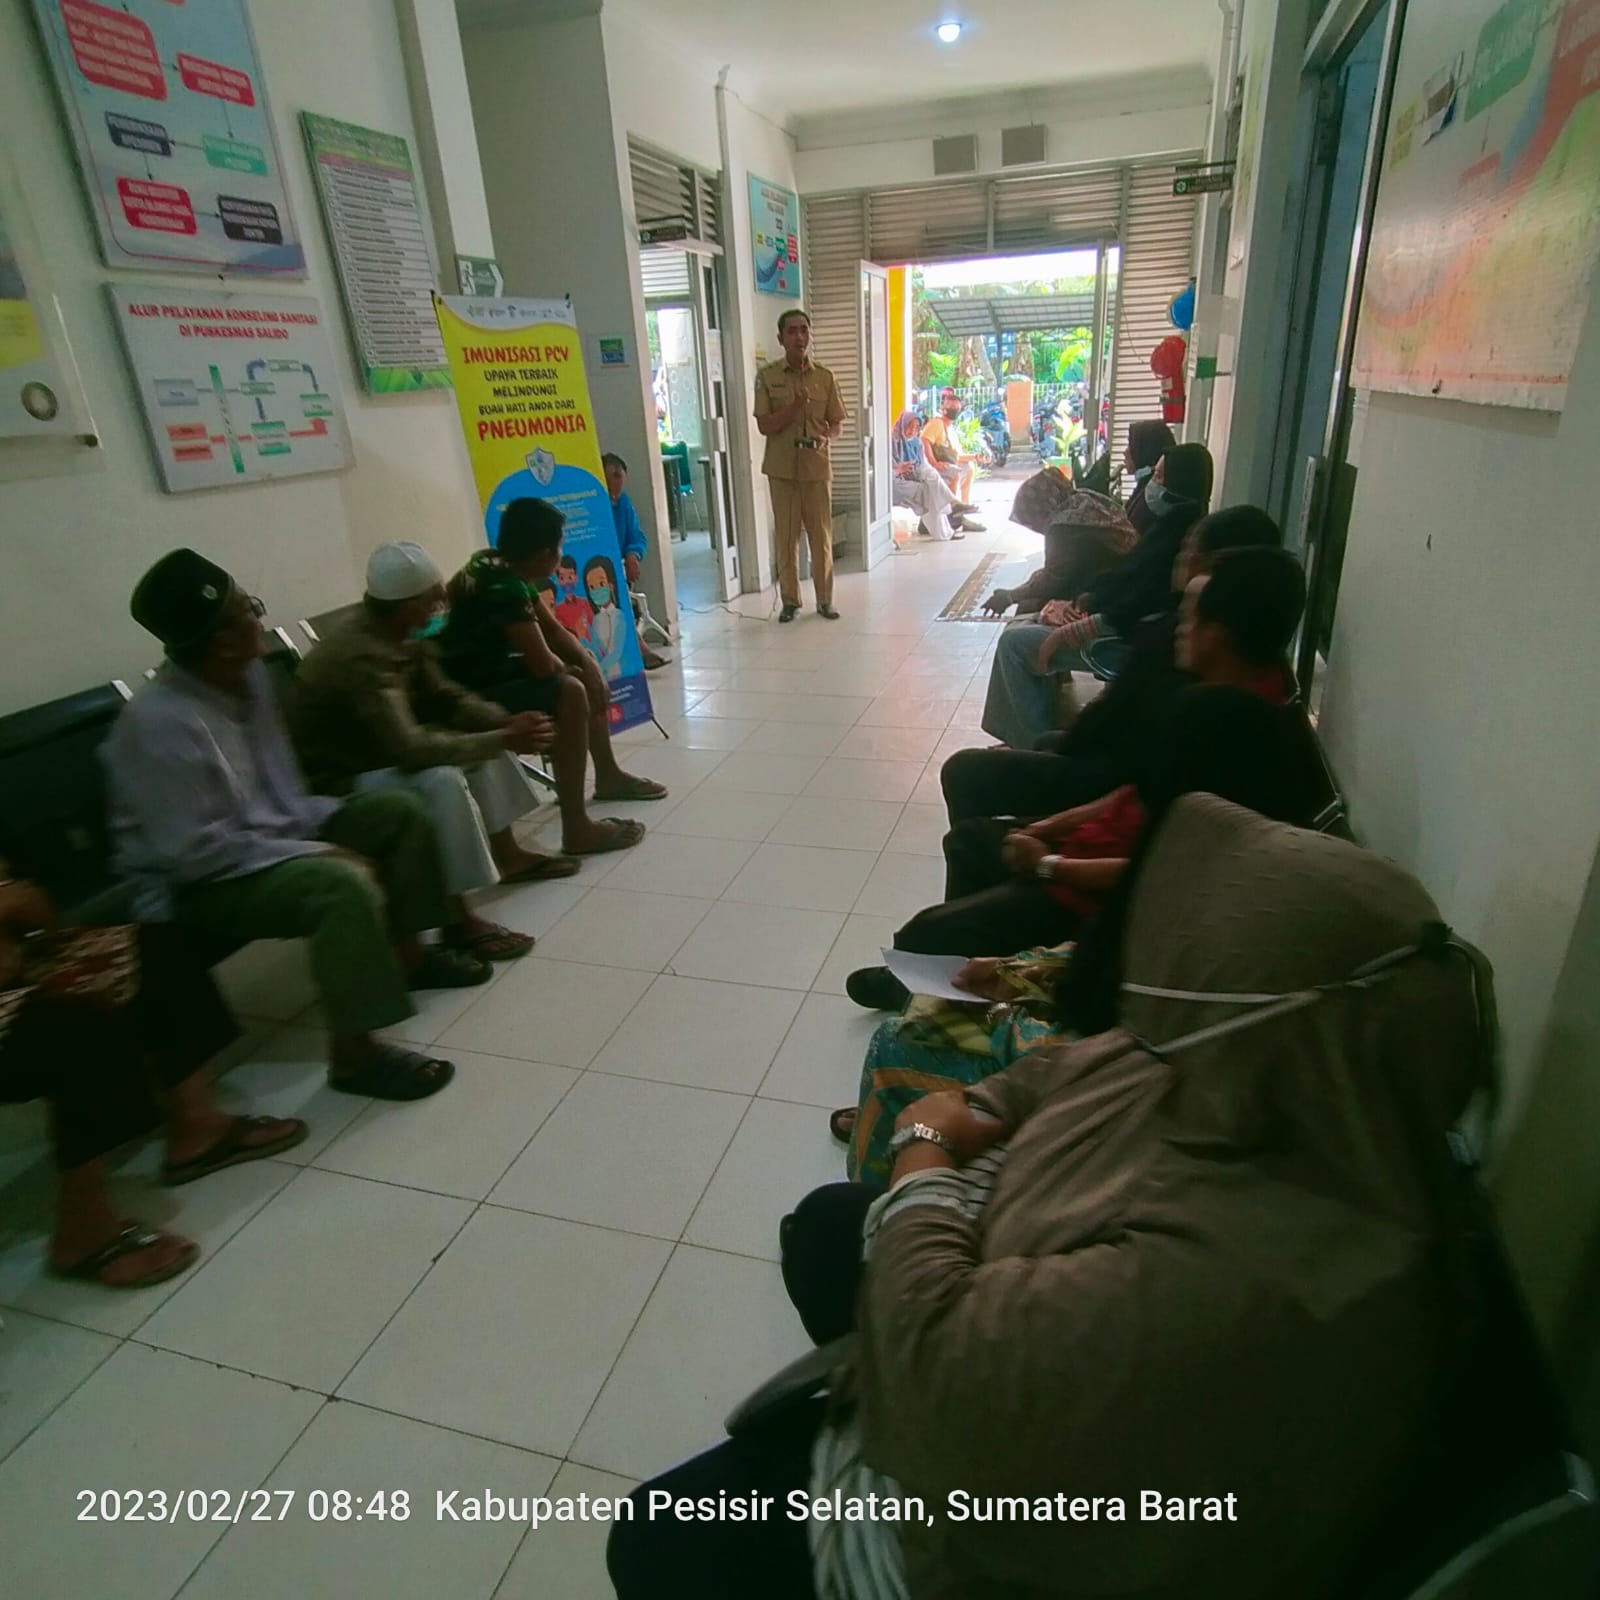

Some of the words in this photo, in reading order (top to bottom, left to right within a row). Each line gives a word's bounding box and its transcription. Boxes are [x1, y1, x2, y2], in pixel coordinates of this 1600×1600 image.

[129, 303, 160, 318] ALUR
[162, 305, 224, 321] PELAYANAN
[179, 324, 191, 337] DI
[193, 325, 254, 338] PUSKESMAS
[463, 346, 541, 364] IMUNISASI
[545, 346, 569, 362] PCV
[484, 369, 517, 381] UPAYA
[518, 368, 558, 380] TERBAIK
[493, 384, 557, 397] MELINDUNGI
[479, 403, 504, 416] BUAH
[505, 402, 526, 414] HATI
[529, 401, 552, 412] ANDA
[555, 400, 575, 410] DARI
[477, 414, 586, 441] PNEUMONIA
